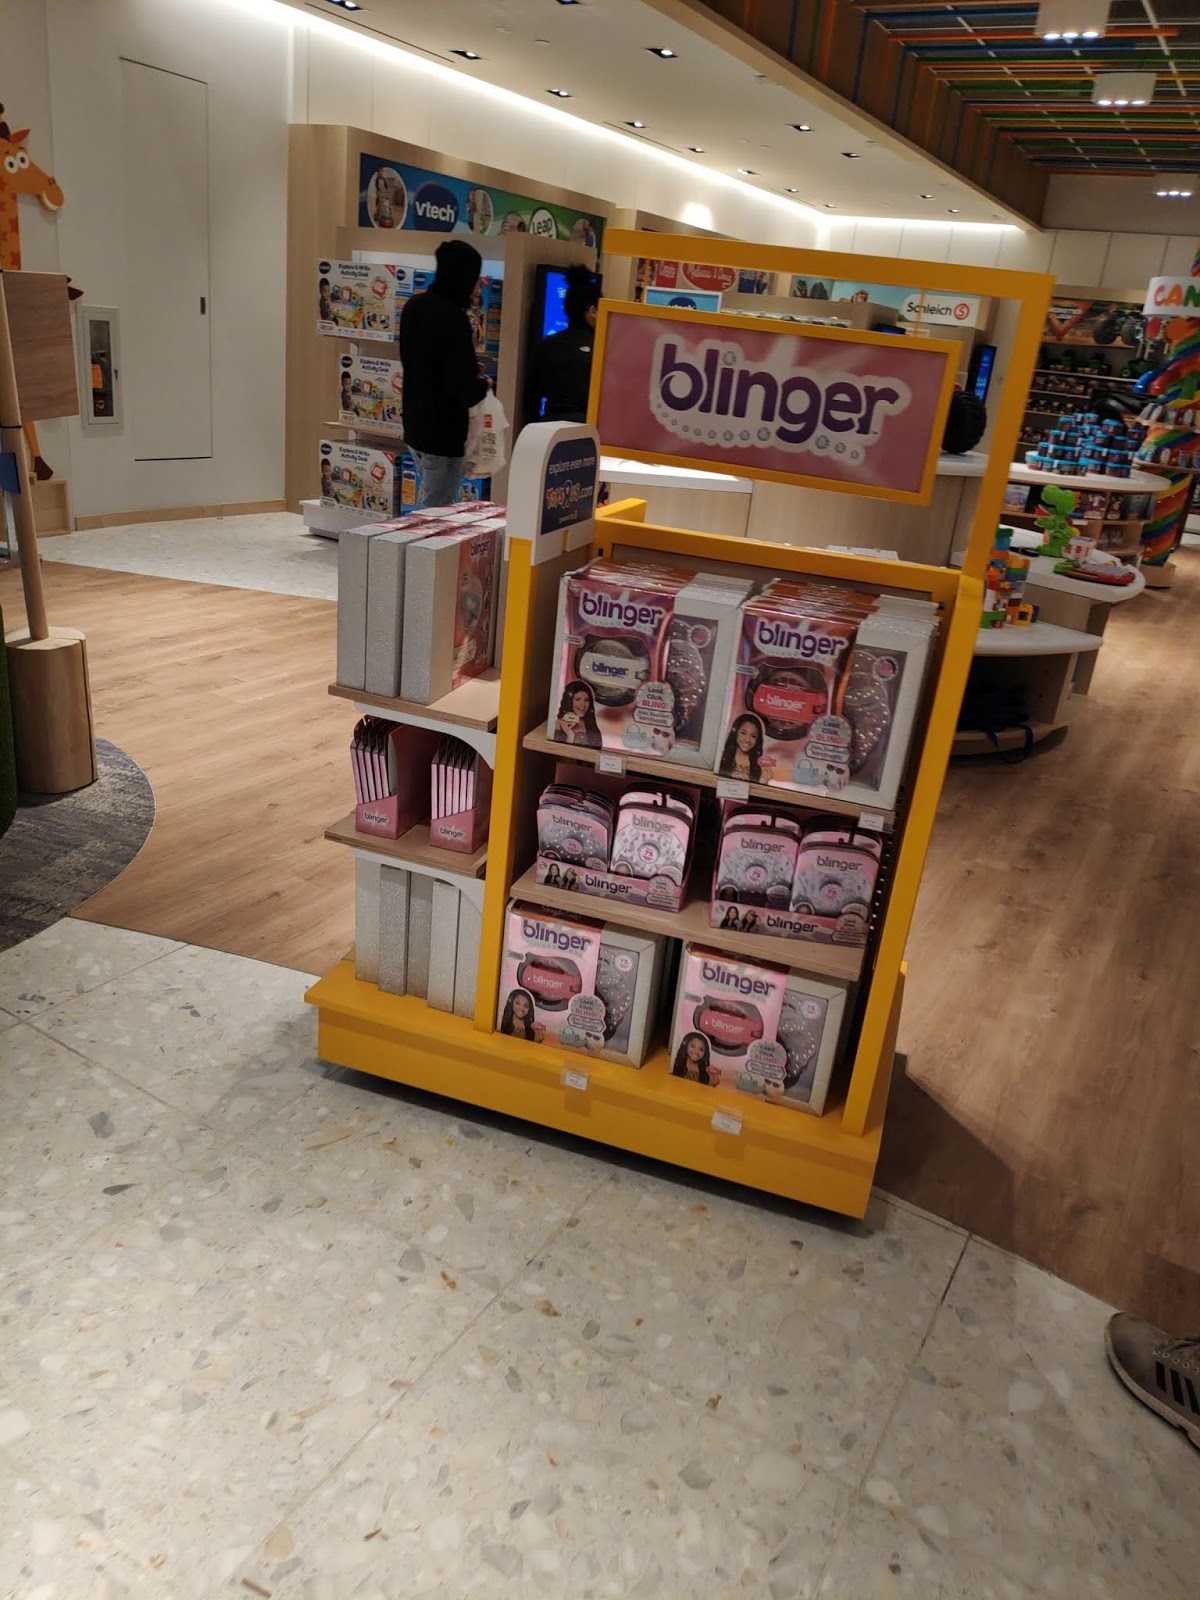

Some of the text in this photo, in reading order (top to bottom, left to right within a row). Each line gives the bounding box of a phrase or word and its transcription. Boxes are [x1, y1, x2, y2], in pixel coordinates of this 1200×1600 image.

[415, 201, 455, 223] vtech
[907, 302, 951, 316] Schleich
[660, 343, 899, 444] blinger
[583, 593, 662, 626] blinger
[759, 621, 847, 657] blinger
[593, 662, 629, 676] blinger
[766, 694, 807, 711] blinger
[364, 812, 388, 824] blinger
[552, 815, 592, 831] blinger
[632, 814, 675, 833] blinger
[440, 827, 464, 838] blinger
[741, 838, 786, 853] blinger
[817, 856, 863, 871] blinger
[585, 874, 632, 894] blinger
[767, 915, 818, 933] blinger
[523, 920, 591, 950] blinger
[532, 974, 563, 989] blinger
[702, 962, 775, 996] blinger
[711, 1018, 744, 1033] blinger
